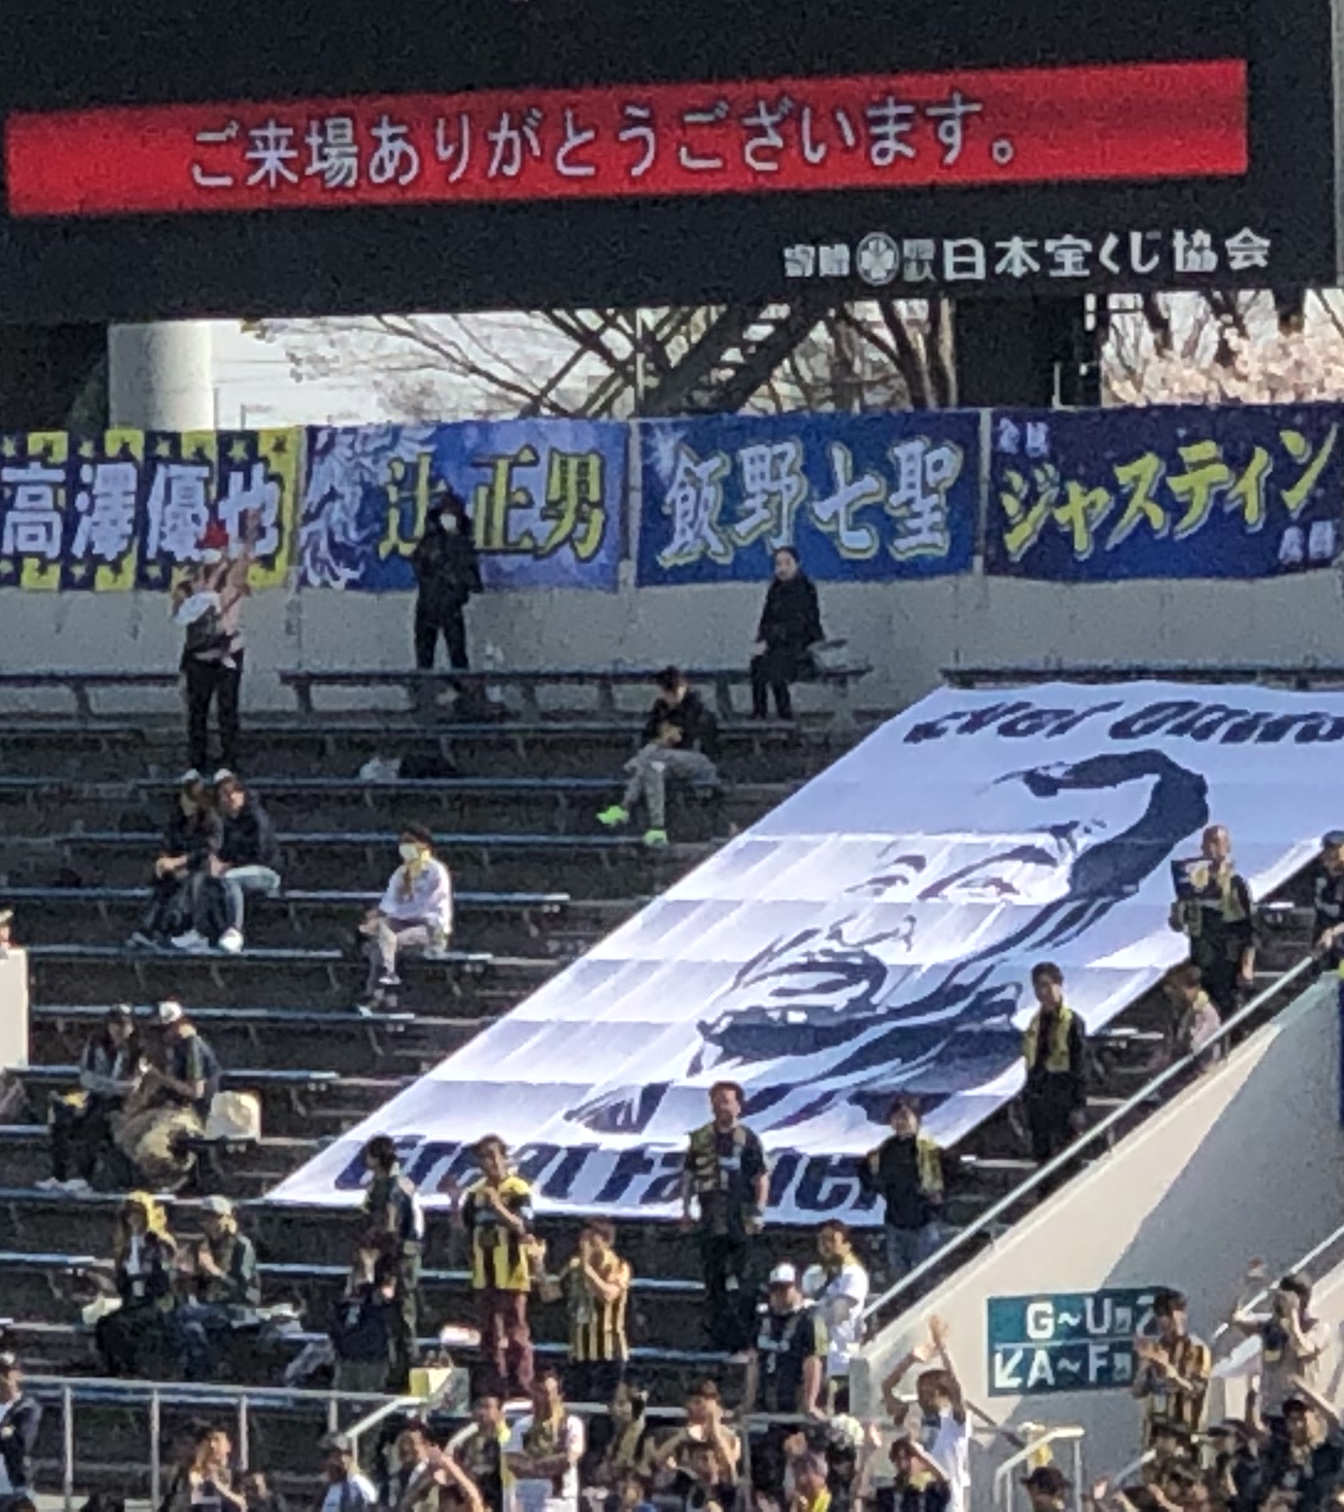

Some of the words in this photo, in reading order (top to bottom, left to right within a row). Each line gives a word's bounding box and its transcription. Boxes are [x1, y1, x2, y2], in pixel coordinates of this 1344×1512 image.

[191, 93, 1014, 188] ご来場ありがとうございます。
[943, 226, 1272, 281] 日本宝くじ協会
[657, 435, 963, 568] 飯野七聖
[1001, 422, 1339, 563] ジャスティン
